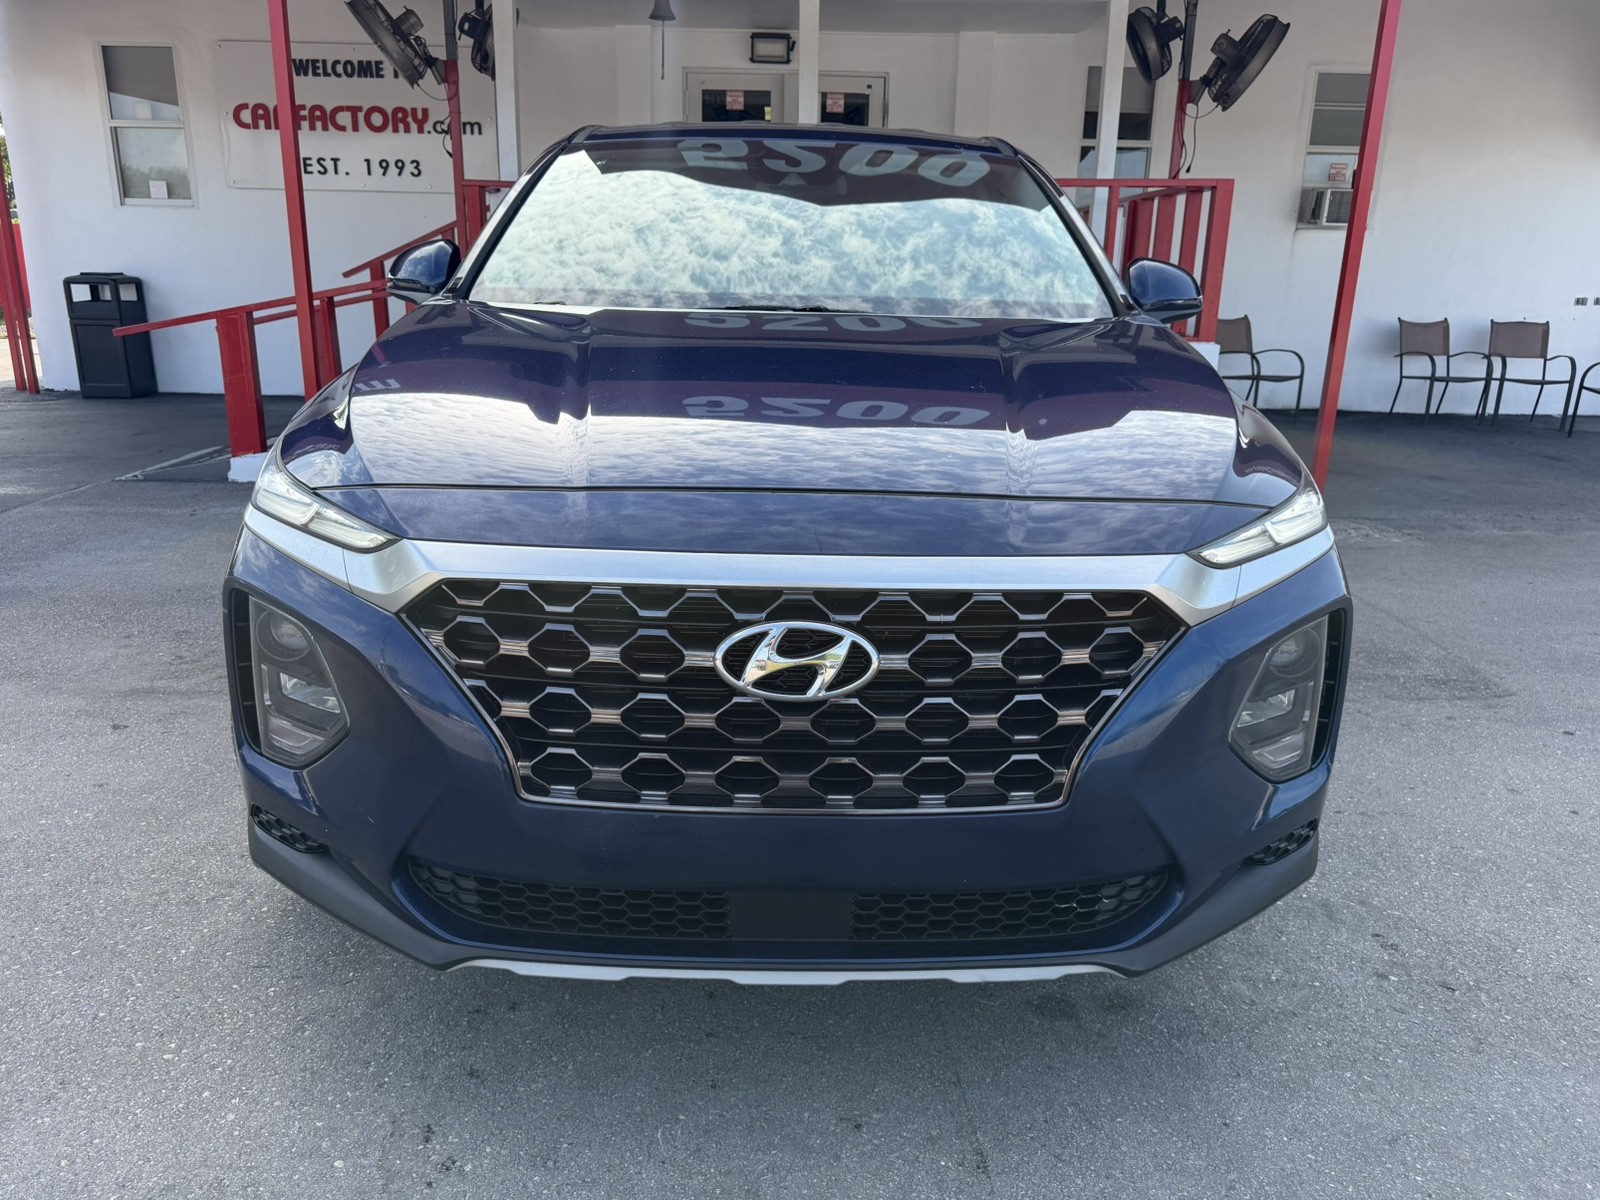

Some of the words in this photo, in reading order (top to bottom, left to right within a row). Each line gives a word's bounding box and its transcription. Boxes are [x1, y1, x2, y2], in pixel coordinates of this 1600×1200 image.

[292, 58, 385, 79] WELCOME
[302, 156, 350, 176] EST.
[363, 158, 422, 177] 1993
